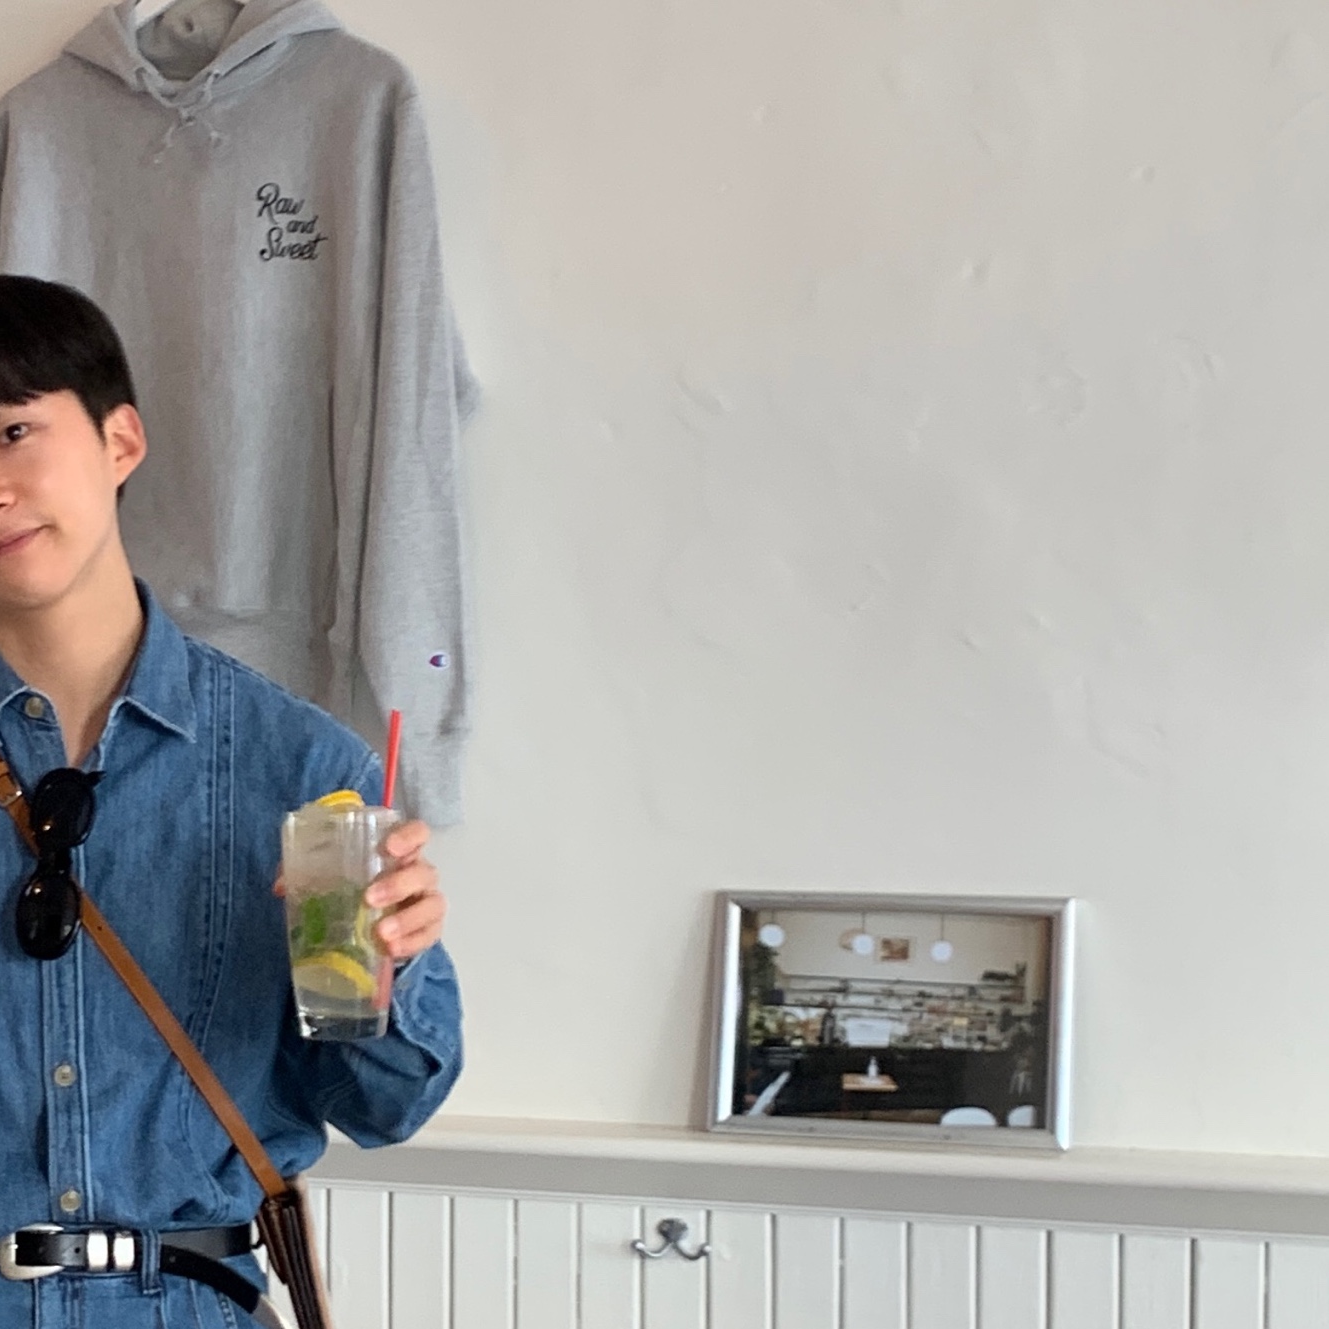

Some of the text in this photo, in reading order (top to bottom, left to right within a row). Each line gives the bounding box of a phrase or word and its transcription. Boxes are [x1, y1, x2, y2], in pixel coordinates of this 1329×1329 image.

[256, 182, 306, 226] Raw
[287, 215, 319, 234] and
[259, 226, 329, 262] Sweet
